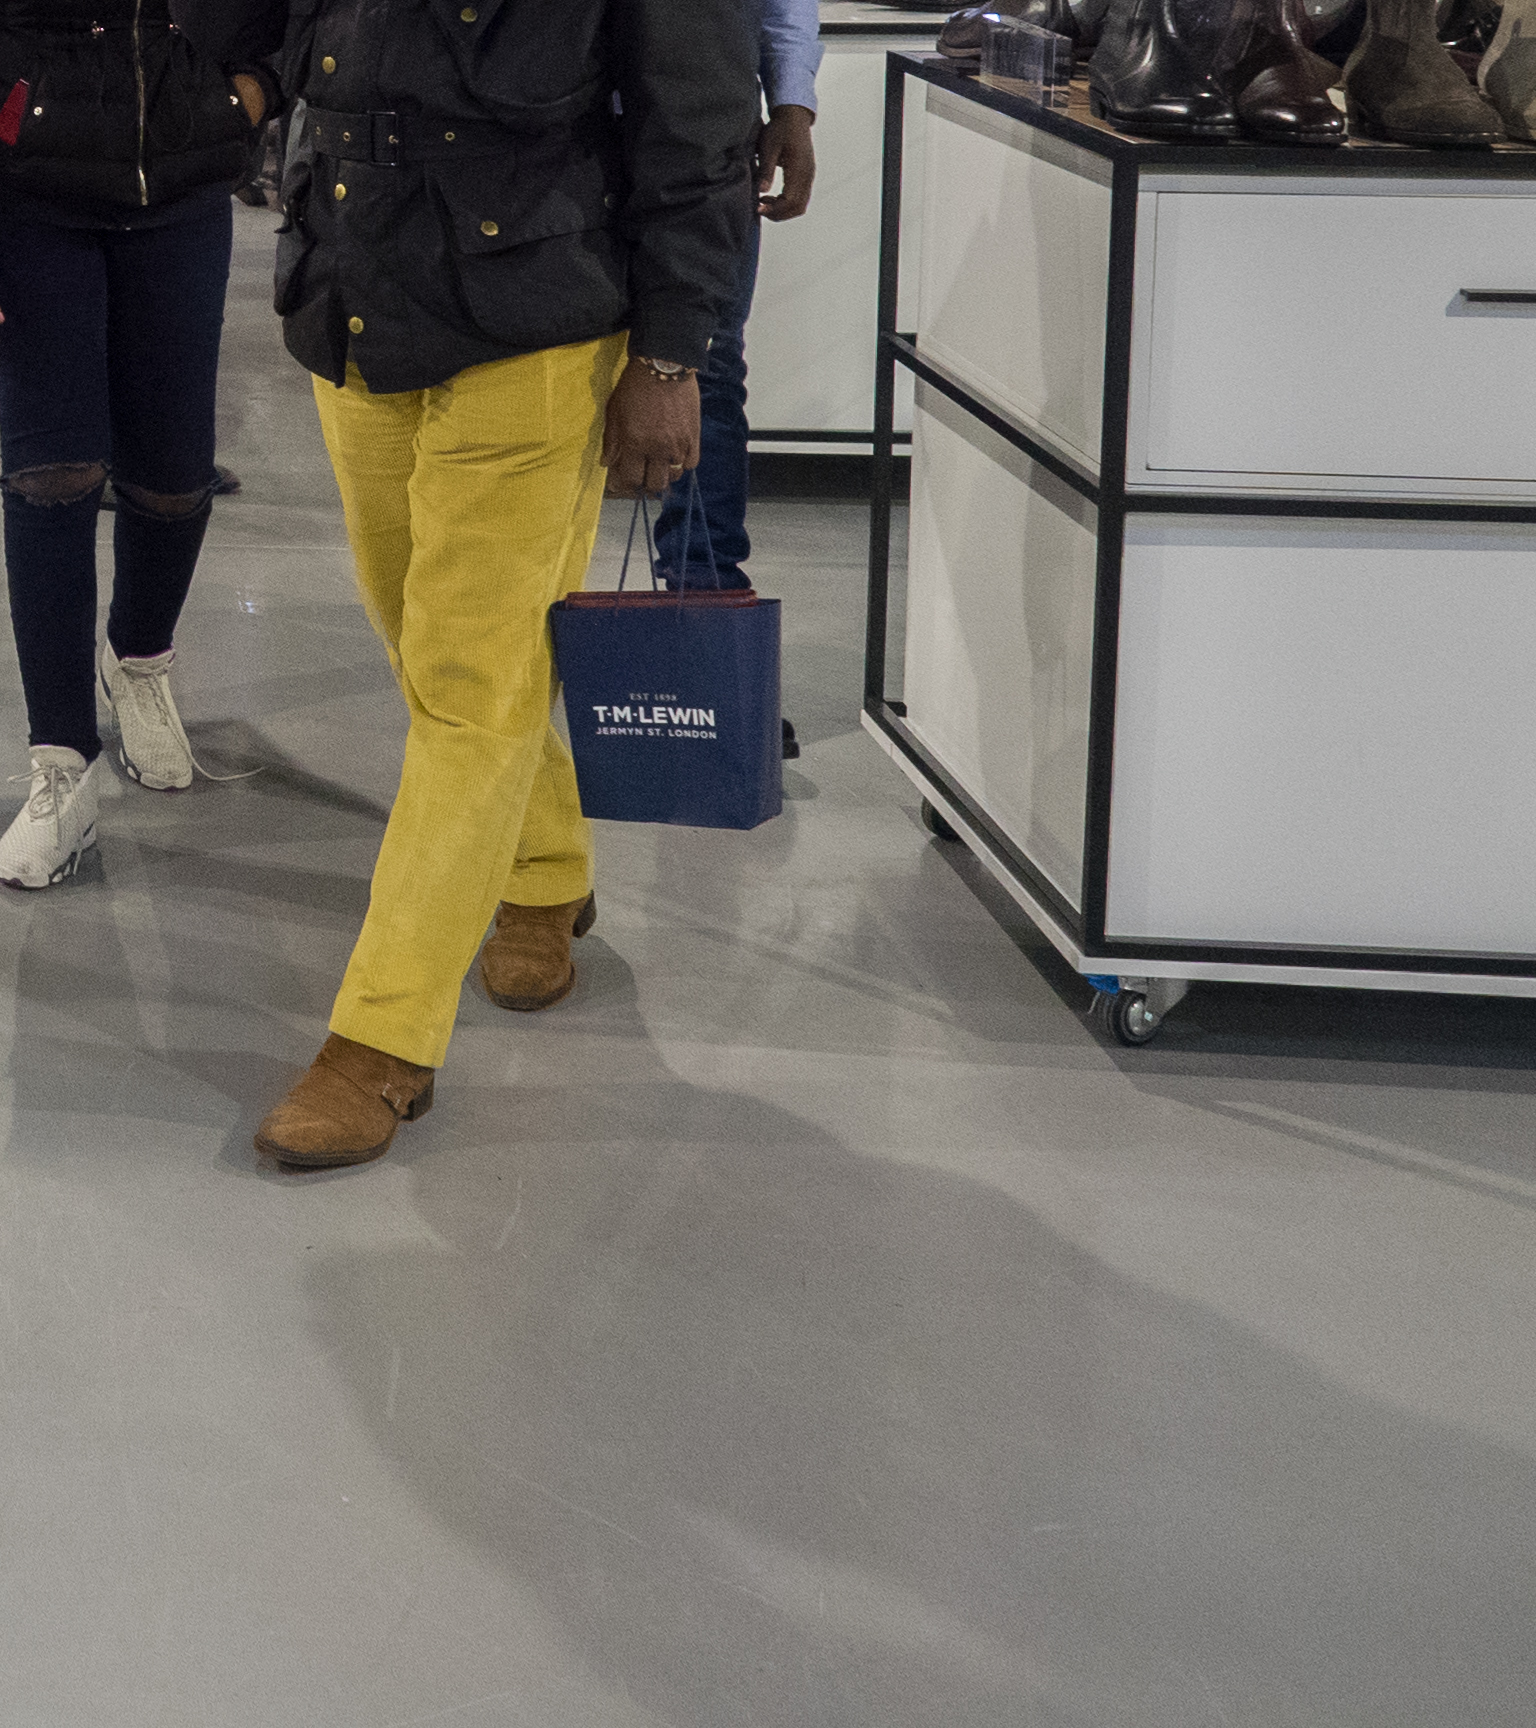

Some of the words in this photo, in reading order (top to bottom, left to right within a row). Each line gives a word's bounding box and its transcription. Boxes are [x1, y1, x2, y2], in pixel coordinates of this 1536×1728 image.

[629, 692, 649, 701] EST
[596, 727, 643, 736] JERMYN
[648, 728, 664, 736] ST.
[668, 729, 717, 739] LONDON
